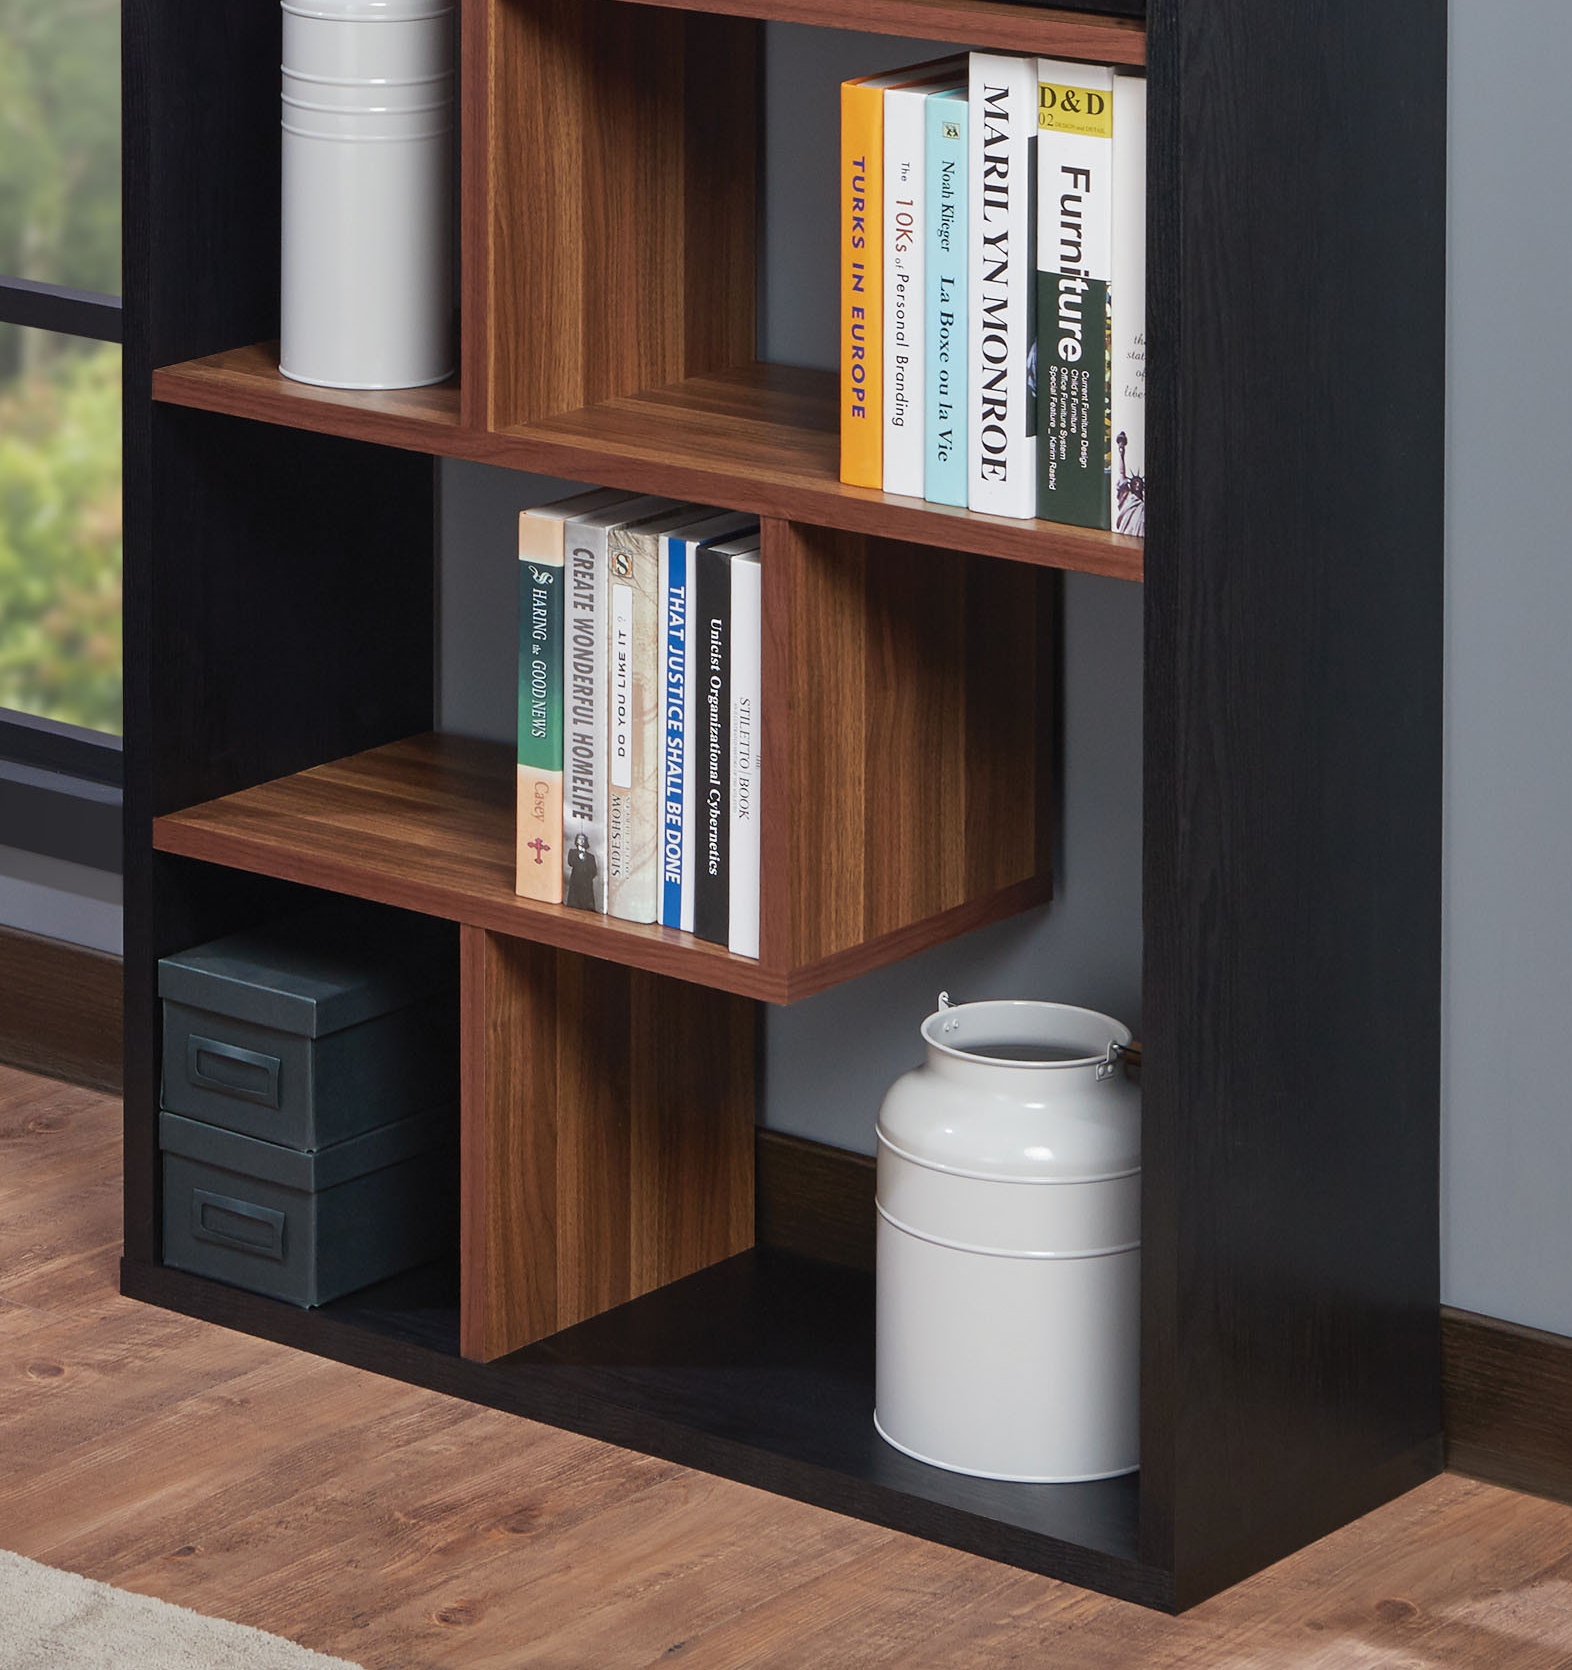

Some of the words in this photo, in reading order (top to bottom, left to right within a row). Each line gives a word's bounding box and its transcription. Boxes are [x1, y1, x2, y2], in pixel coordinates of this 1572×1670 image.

[901, 162, 910, 182] The
[942, 160, 955, 199] Noah
[852, 156, 865, 249] TURKS
[895, 200, 914, 252] 10Ks
[937, 203, 954, 252] Klieger
[852, 263, 865, 292] IN
[895, 258, 904, 269] of
[1058, 166, 1091, 362] Furniture
[940, 276, 955, 303] La
[896, 274, 909, 347] Personal
[939, 310, 954, 363] Boxe
[1134, 333, 1146, 345] th
[851, 306, 865, 419] EUROPE
[1049, 365, 1058, 395] Special
[1060, 367, 1068, 391] Office
[892, 355, 909, 427] Branding
[939, 370, 949, 396] ou
[981, 294, 1009, 482] MONROE
[1081, 370, 1090, 401] Current
[939, 403, 953, 420] la
[1049, 396, 1057, 428] Feature
[1059, 392, 1068, 428] Furniture
[1070, 397, 1078, 434] Furniture
[1081, 402, 1089, 438] Furniture
[937, 428, 952, 462] Vie
[1049, 436, 1057, 460] Karim
[1058, 429, 1068, 460] System
[1079, 440, 1089, 468] Design
[573, 547, 595, 612] CREATE
[669, 586, 684, 641] THAT
[532, 644, 542, 655] the
[618, 629, 627, 646] IT
[710, 618, 722, 671] Unicist
[531, 660, 546, 699] GOOD
[572, 618, 594, 726] WONDERFUL
[618, 651, 626, 689] LIKE
[667, 645, 684, 732] JUSTICE
[531, 700, 546, 738] NEWS
[618, 694, 626, 726] YOU
[618, 734, 626, 758] DO
[707, 675, 721, 785] Organizational
[739, 697, 751, 769] STILETTO
[572, 732, 594, 822] HOMELIFE
[666, 736, 683, 797] SHALL
[531, 781, 550, 822] Casey
[666, 801, 681, 826] BE
[738, 777, 751, 821] BOOK
[611, 793, 622, 877] SIDESHOW
[707, 789, 720, 875] Cybernetics
[665, 829, 681, 884] DONE
